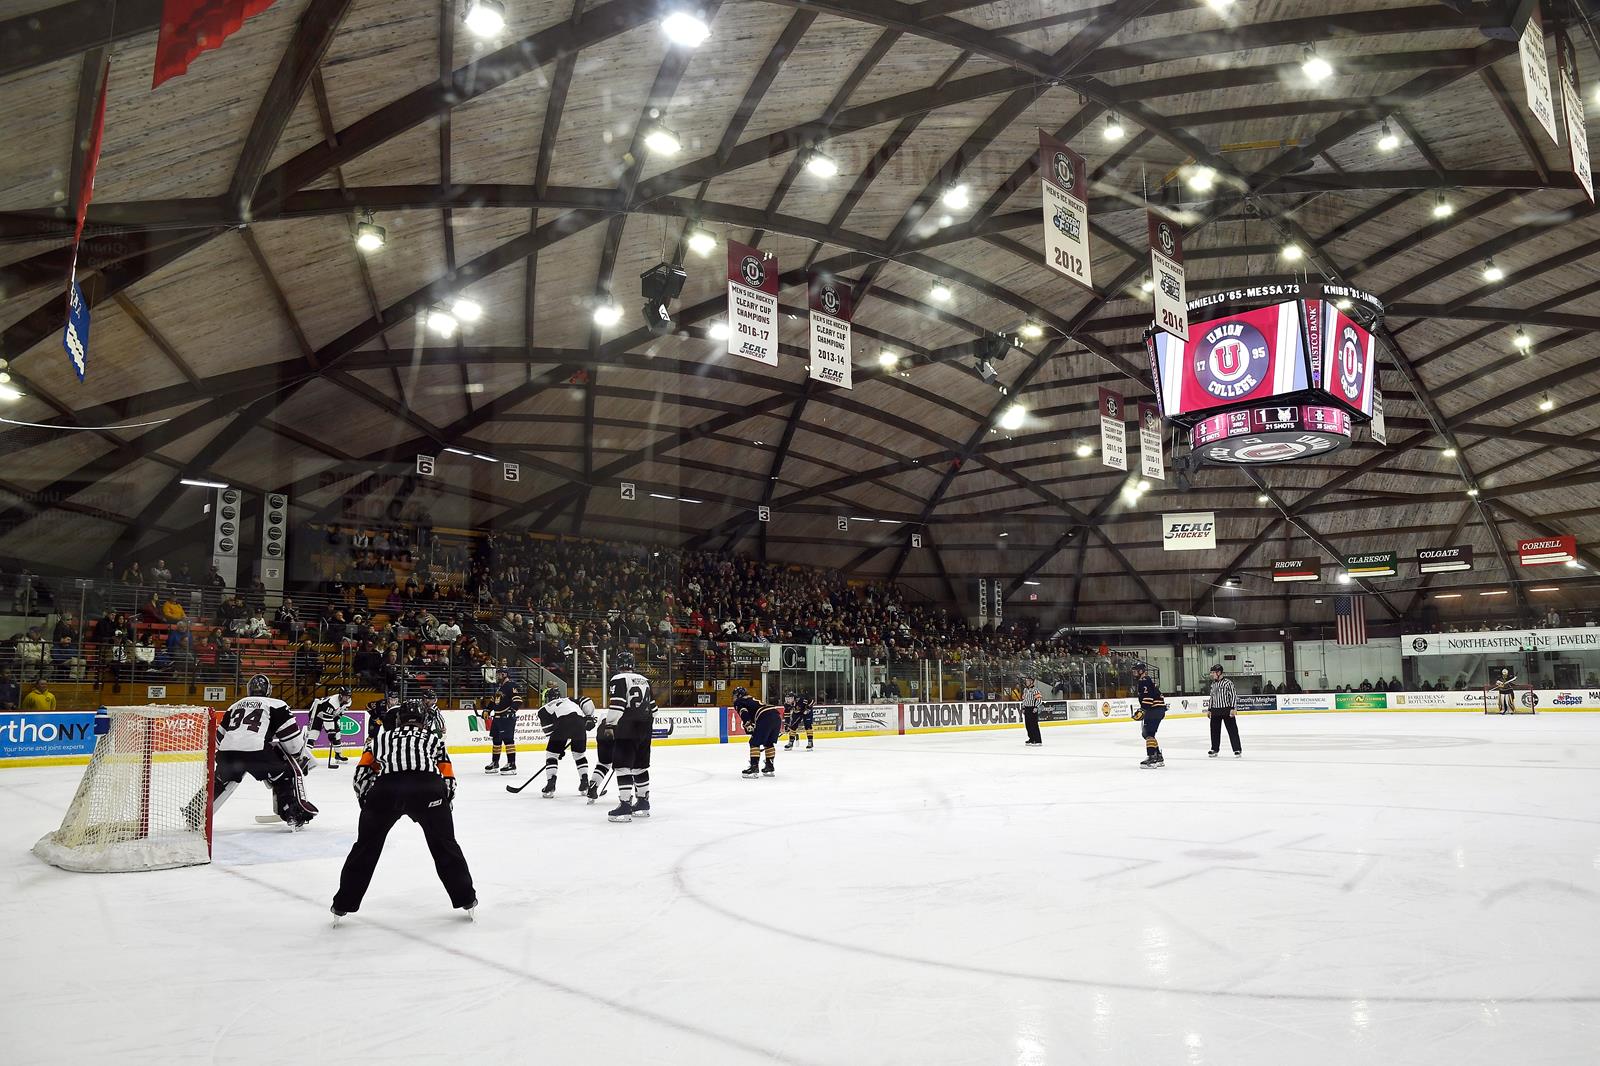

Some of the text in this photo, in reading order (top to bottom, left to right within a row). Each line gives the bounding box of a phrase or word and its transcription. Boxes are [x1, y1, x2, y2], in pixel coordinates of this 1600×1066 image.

[1054, 246, 1083, 277] 2012
[736, 297, 772, 315] CLEARY CUP
[755, 294, 775, 306] HOCKEY
[736, 308, 770, 325] CHAMPIONS
[1162, 308, 1184, 333] 2014
[737, 322, 770, 341] 2016-17
[1206, 324, 1244, 344] UNION
[1310, 308, 1321, 373] TRUSTCO BANK
[742, 342, 768, 355] ECAC
[745, 349, 766, 359] HOCKEY
[1251, 346, 1266, 359] 95
[818, 349, 845, 365] 2013-14
[1215, 343, 1241, 376] U
[1196, 360, 1206, 372] 17
[822, 367, 844, 378] ECAC
[1207, 373, 1258, 397] COLLEGE
[1259, 409, 1266, 422] 1
[1274, 422, 1295, 430] SHOTS
[419, 461, 433, 474] 6
[505, 468, 518, 480] 5
[622, 488, 633, 498] 4
[760, 510, 769, 520] 3
[839, 520, 847, 530] 2
[1170, 522, 1213, 532] ECAC
[1174, 531, 1210, 539] HOCKEY
[913, 538, 920, 547] 1
[1522, 540, 1562, 550] CORNELL
[1347, 554, 1391, 564] CLARKSON
[1419, 549, 1459, 559] COLGATE
[1274, 560, 1303, 569] BROWN
[1448, 634, 1597, 649] NORTHEASTERN FINE JEWELRY
[210, 692, 220, 700] H
[1143, 686, 1149, 694] 2
[237, 701, 262, 709] HANSON
[225, 708, 264, 733] 34
[653, 716, 702, 725] RUSTCO BANK
[909, 704, 963, 727] UNION
[968, 702, 1024, 724] HOCKEY
[391, 730, 429, 739] PLACE
[47, 743, 62, 751] joint
[62, 743, 85, 751] experts
